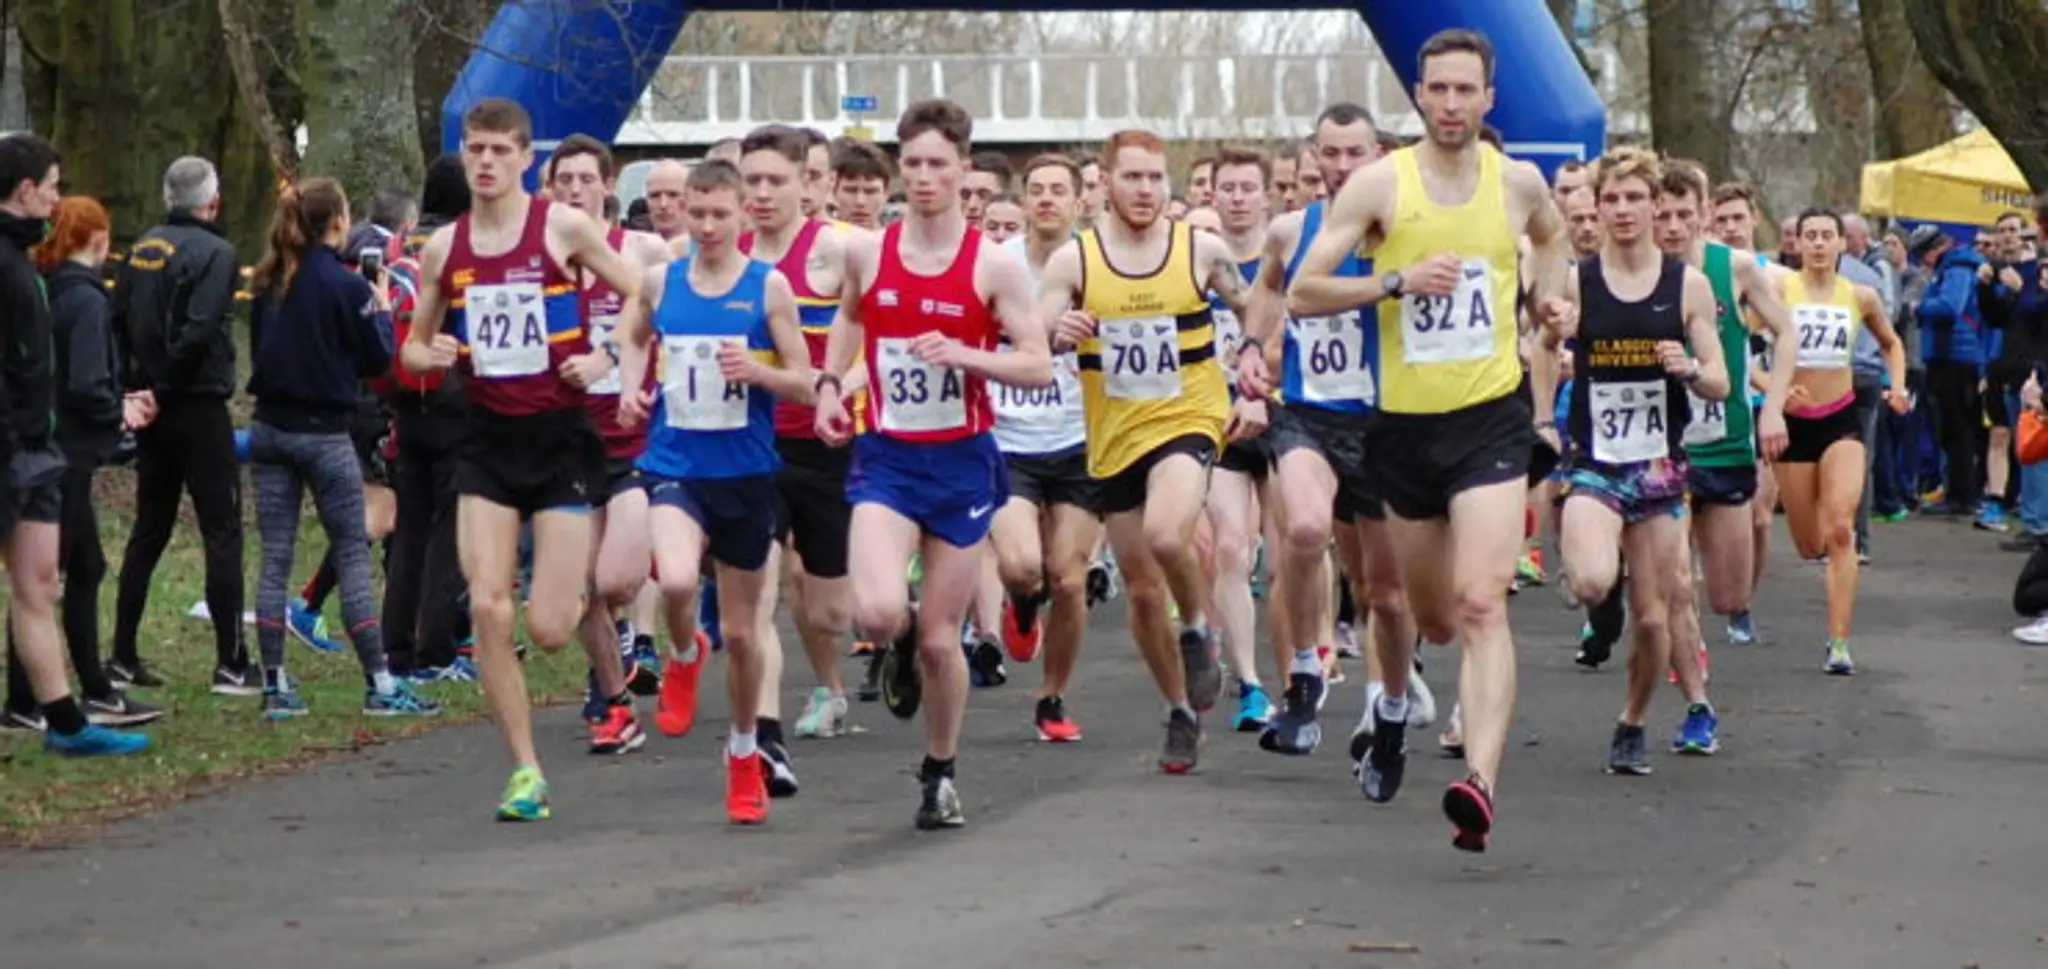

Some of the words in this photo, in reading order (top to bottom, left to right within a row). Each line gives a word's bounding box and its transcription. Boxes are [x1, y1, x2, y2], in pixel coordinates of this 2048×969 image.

[1414, 290, 1455, 333] 32
[1468, 289, 1492, 328] A
[477, 313, 511, 348] 42
[523, 312, 543, 346] A
[1800, 323, 1827, 349] 27
[1832, 326, 1847, 349] A
[1112, 344, 1147, 375] 70
[1157, 341, 1176, 373] A
[1310, 338, 1347, 374] 60
[723, 379, 744, 402] A
[889, 368, 928, 404] 33
[940, 366, 960, 402] A
[1601, 407, 1634, 439] 37
[1646, 404, 1663, 435] A
[1703, 402, 1721, 424] A
